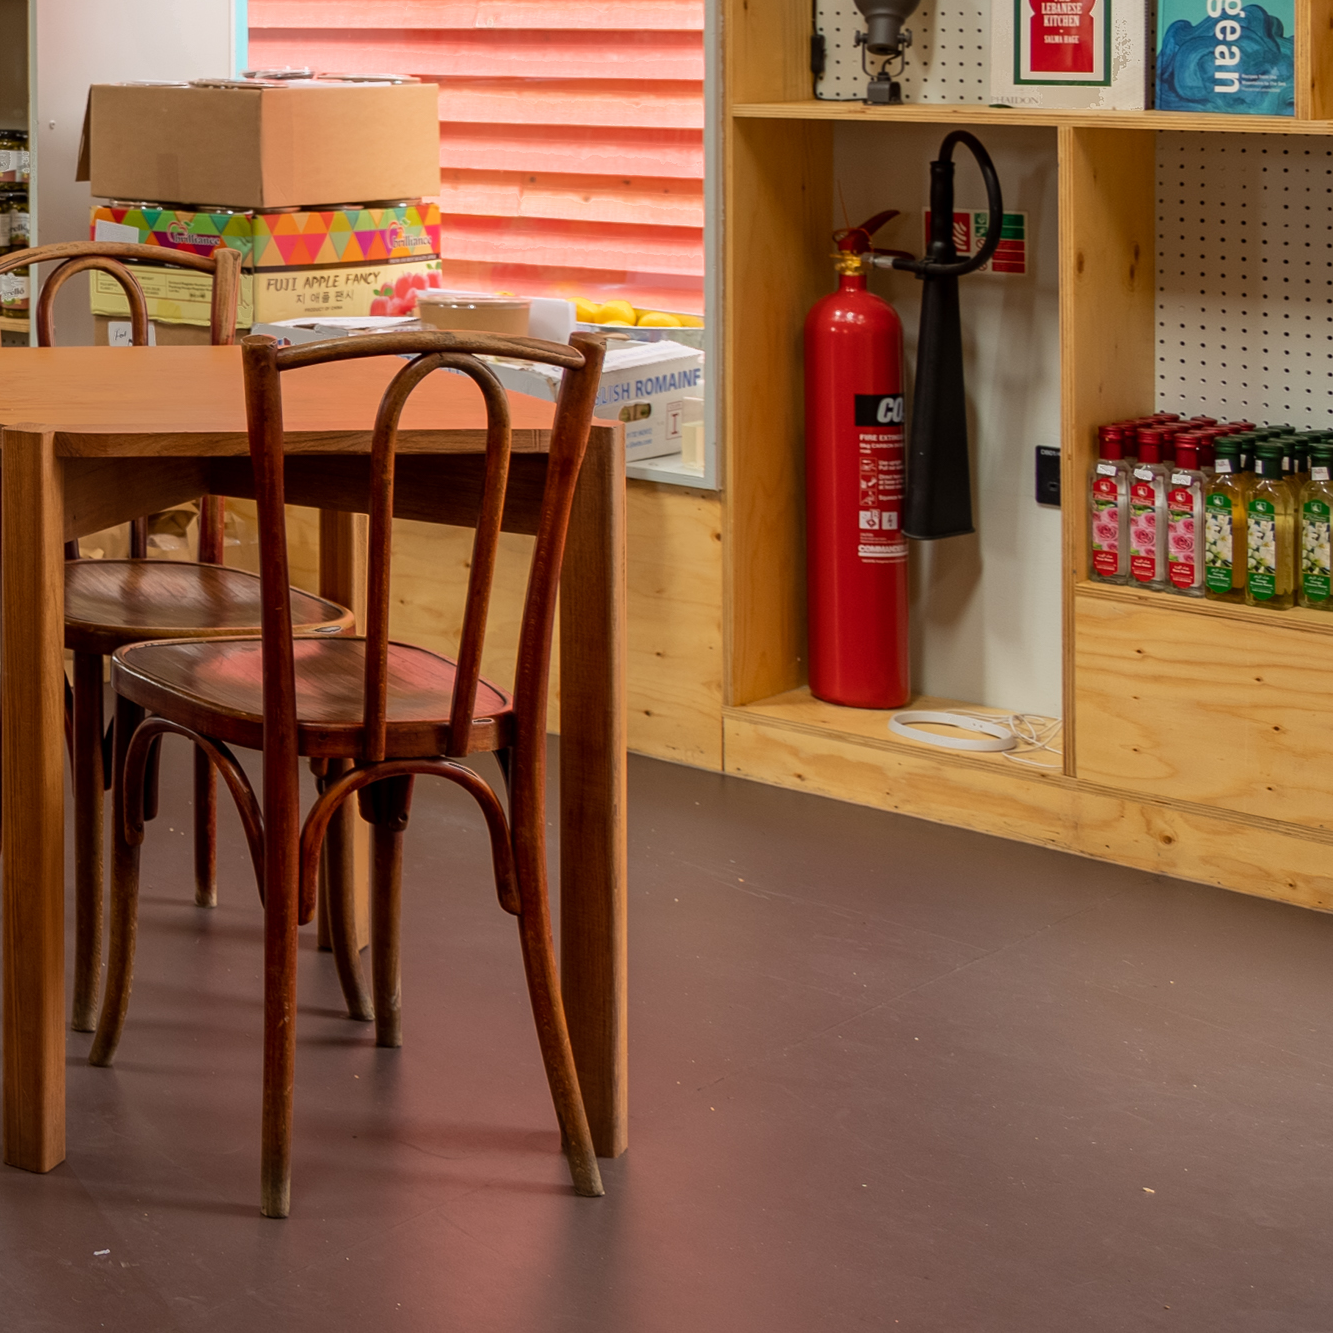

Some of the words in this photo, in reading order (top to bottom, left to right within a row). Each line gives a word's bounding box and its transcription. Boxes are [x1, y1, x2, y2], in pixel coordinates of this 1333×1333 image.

[1041, 3, 1082, 14] LEBANESE
[1043, 16, 1080, 27] KITCHEN
[1044, 35, 1063, 44] SALMA
[1064, 35, 1079, 44] HAGE
[990, 96, 1039, 104] PHAIDON
[173, 232, 220, 246] brilliance
[393, 235, 432, 248] brilliance
[266, 278, 297, 292] FUJI
[303, 274, 340, 289] APPLE
[345, 271, 381, 285] FANCY
[296, 294, 305, 304] 지
[311, 291, 330, 304] 애플
[335, 290, 354, 302] 팬시
[595, 382, 630, 406] LISH
[877, 397, 904, 423] CO
